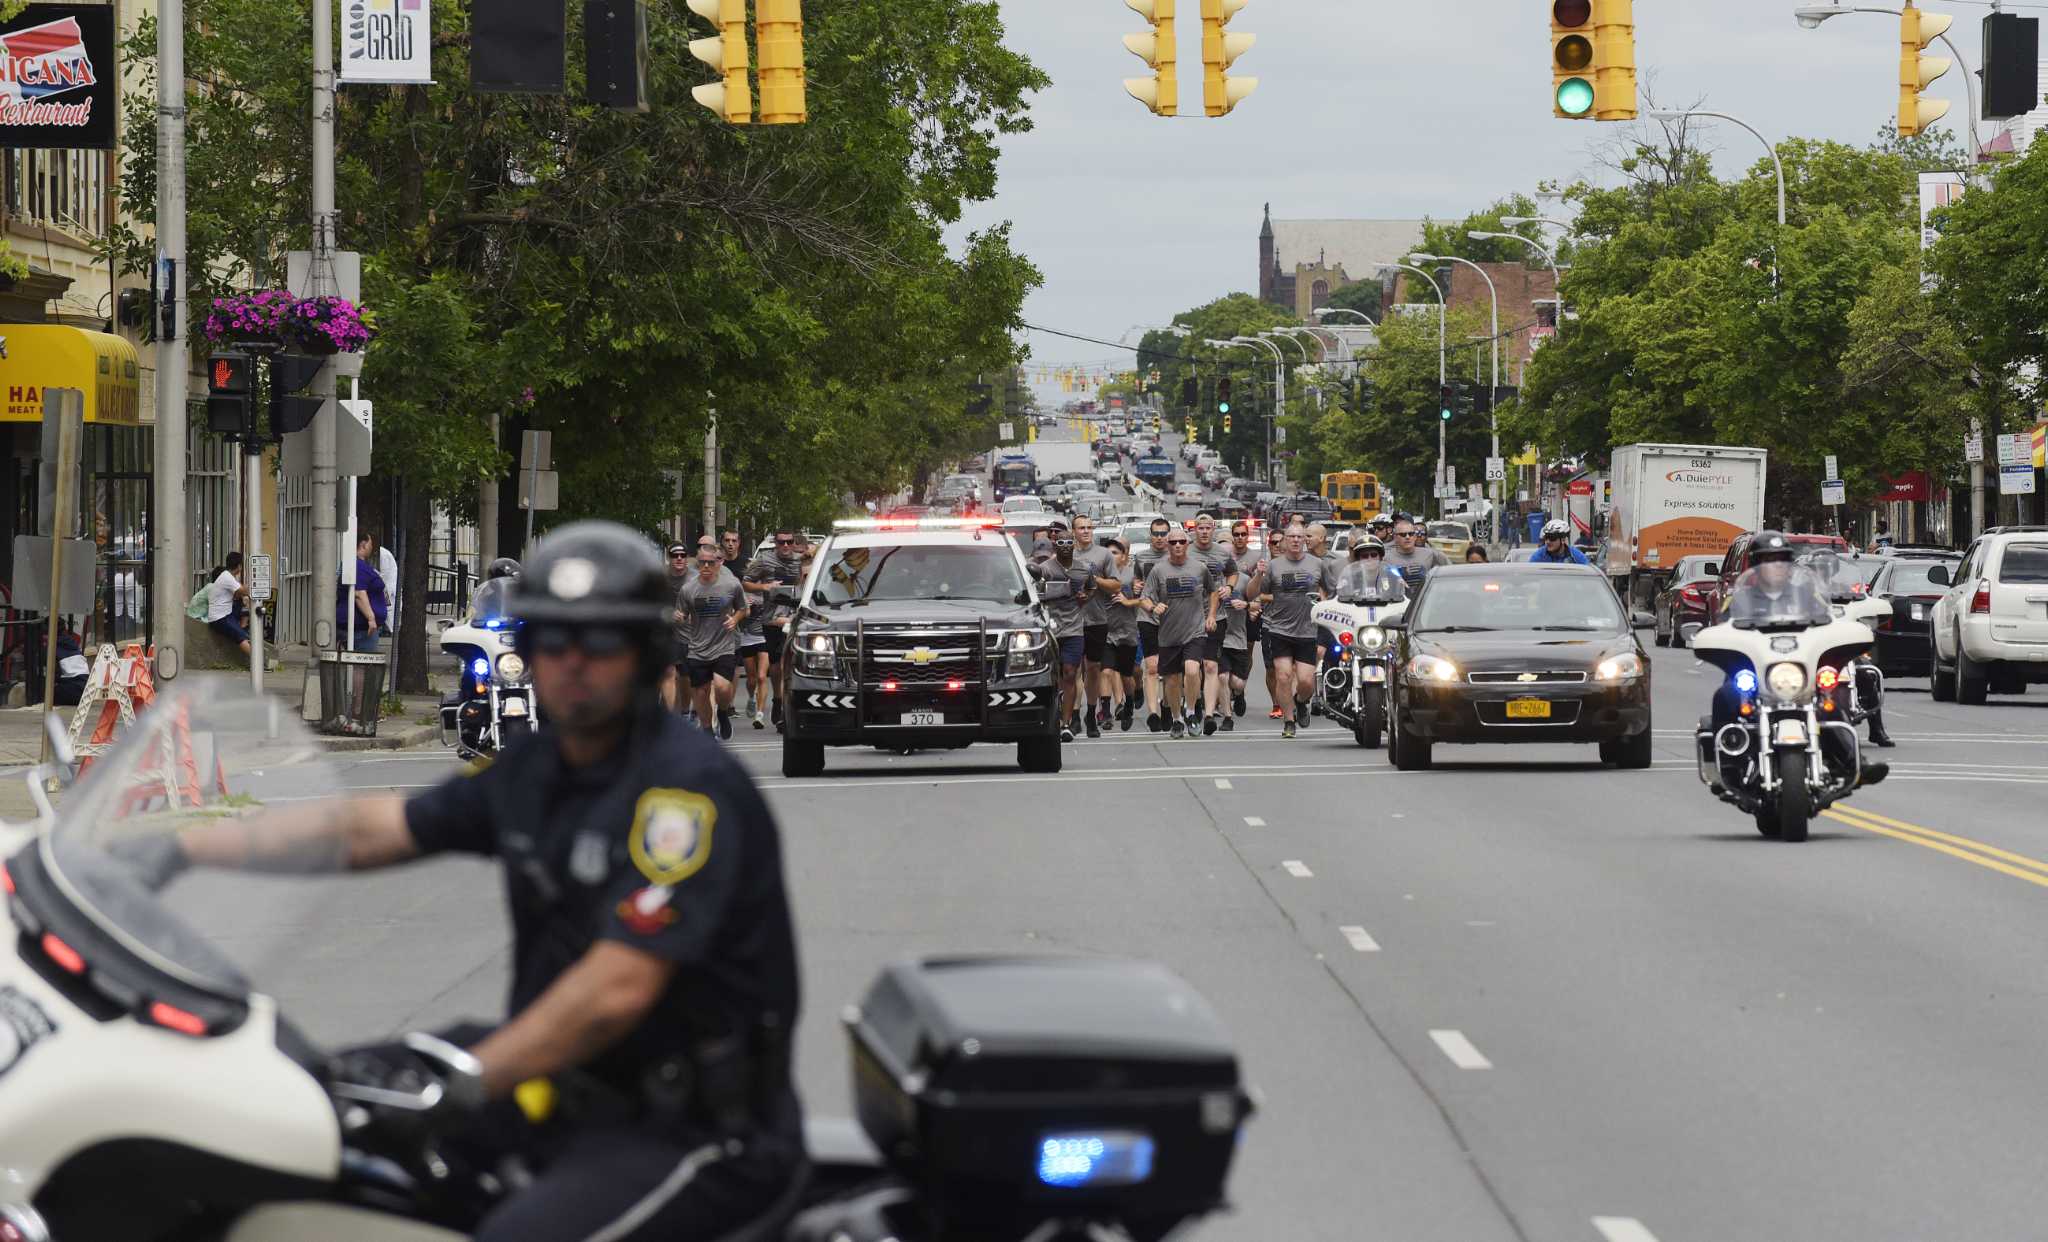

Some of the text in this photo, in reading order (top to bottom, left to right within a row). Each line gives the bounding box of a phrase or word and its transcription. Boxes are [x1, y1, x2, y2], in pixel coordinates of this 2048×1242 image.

[368, 8, 412, 60] GRID
[8, 406, 37, 414] MEAT
[1691, 460, 1712, 468] ES362
[1488, 470, 1502, 479] 30
[1664, 499, 1735, 510] Express Solutions
[1316, 611, 1355, 628] POLICE
[911, 713, 934, 726] 370
